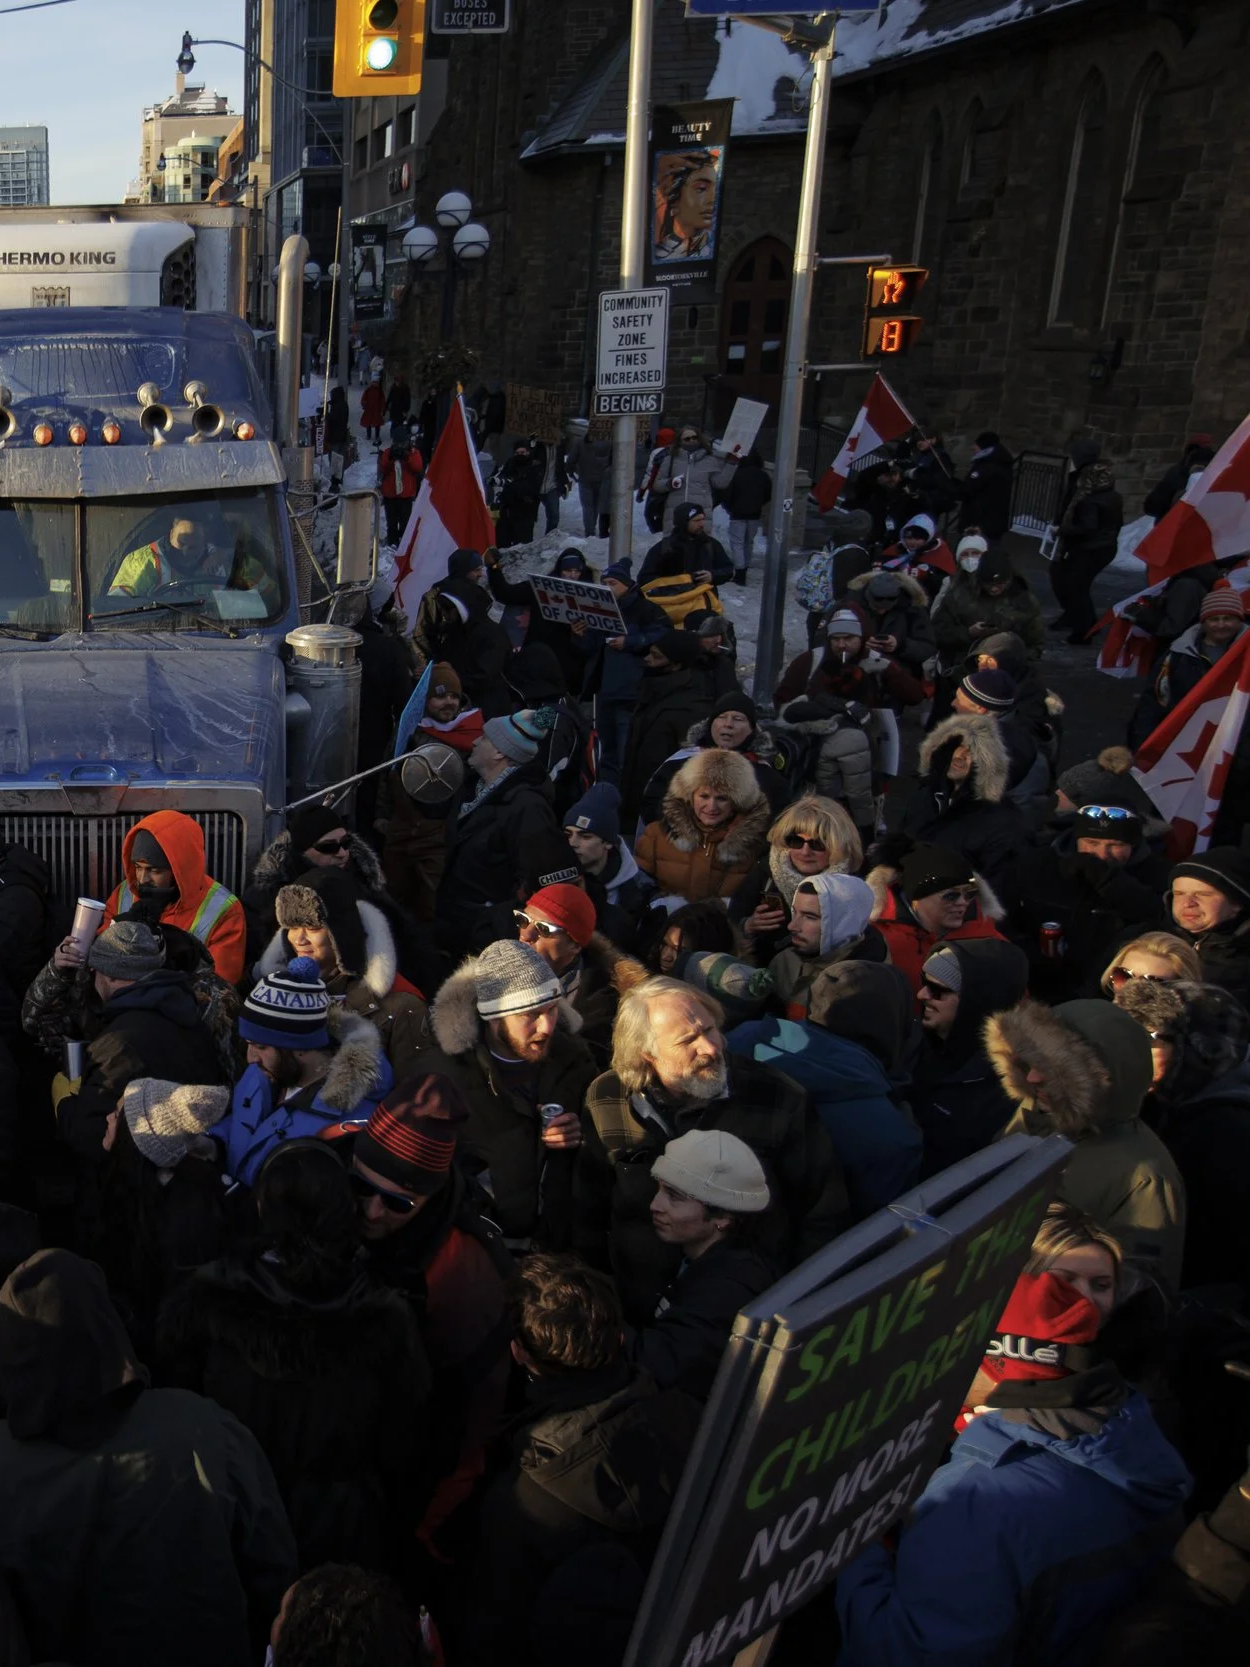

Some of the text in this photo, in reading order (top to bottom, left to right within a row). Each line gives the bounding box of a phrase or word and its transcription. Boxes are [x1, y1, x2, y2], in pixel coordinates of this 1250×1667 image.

[443, 12, 496, 26] EXCEPTED
[672, 121, 712, 134] BEAUTY
[679, 133, 703, 143] TIME
[70, 251, 116, 265] KING
[604, 295, 663, 312] COMMUNITY
[613, 314, 653, 329] SAFETY
[618, 333, 647, 346] ZONE
[616, 353, 647, 366] FINES
[600, 370, 661, 386] INCREASED
[599, 395, 657, 412] BEGINS
[533, 577, 614, 604] FREEDOM
[542, 605, 624, 633] OF CHOICE
[786, 1261, 947, 1402] SAVE
[746, 1286, 1006, 1510] CHILDREN
[739, 1400, 940, 1580] NO MORE
[681, 1463, 922, 1667] MANDATES!
